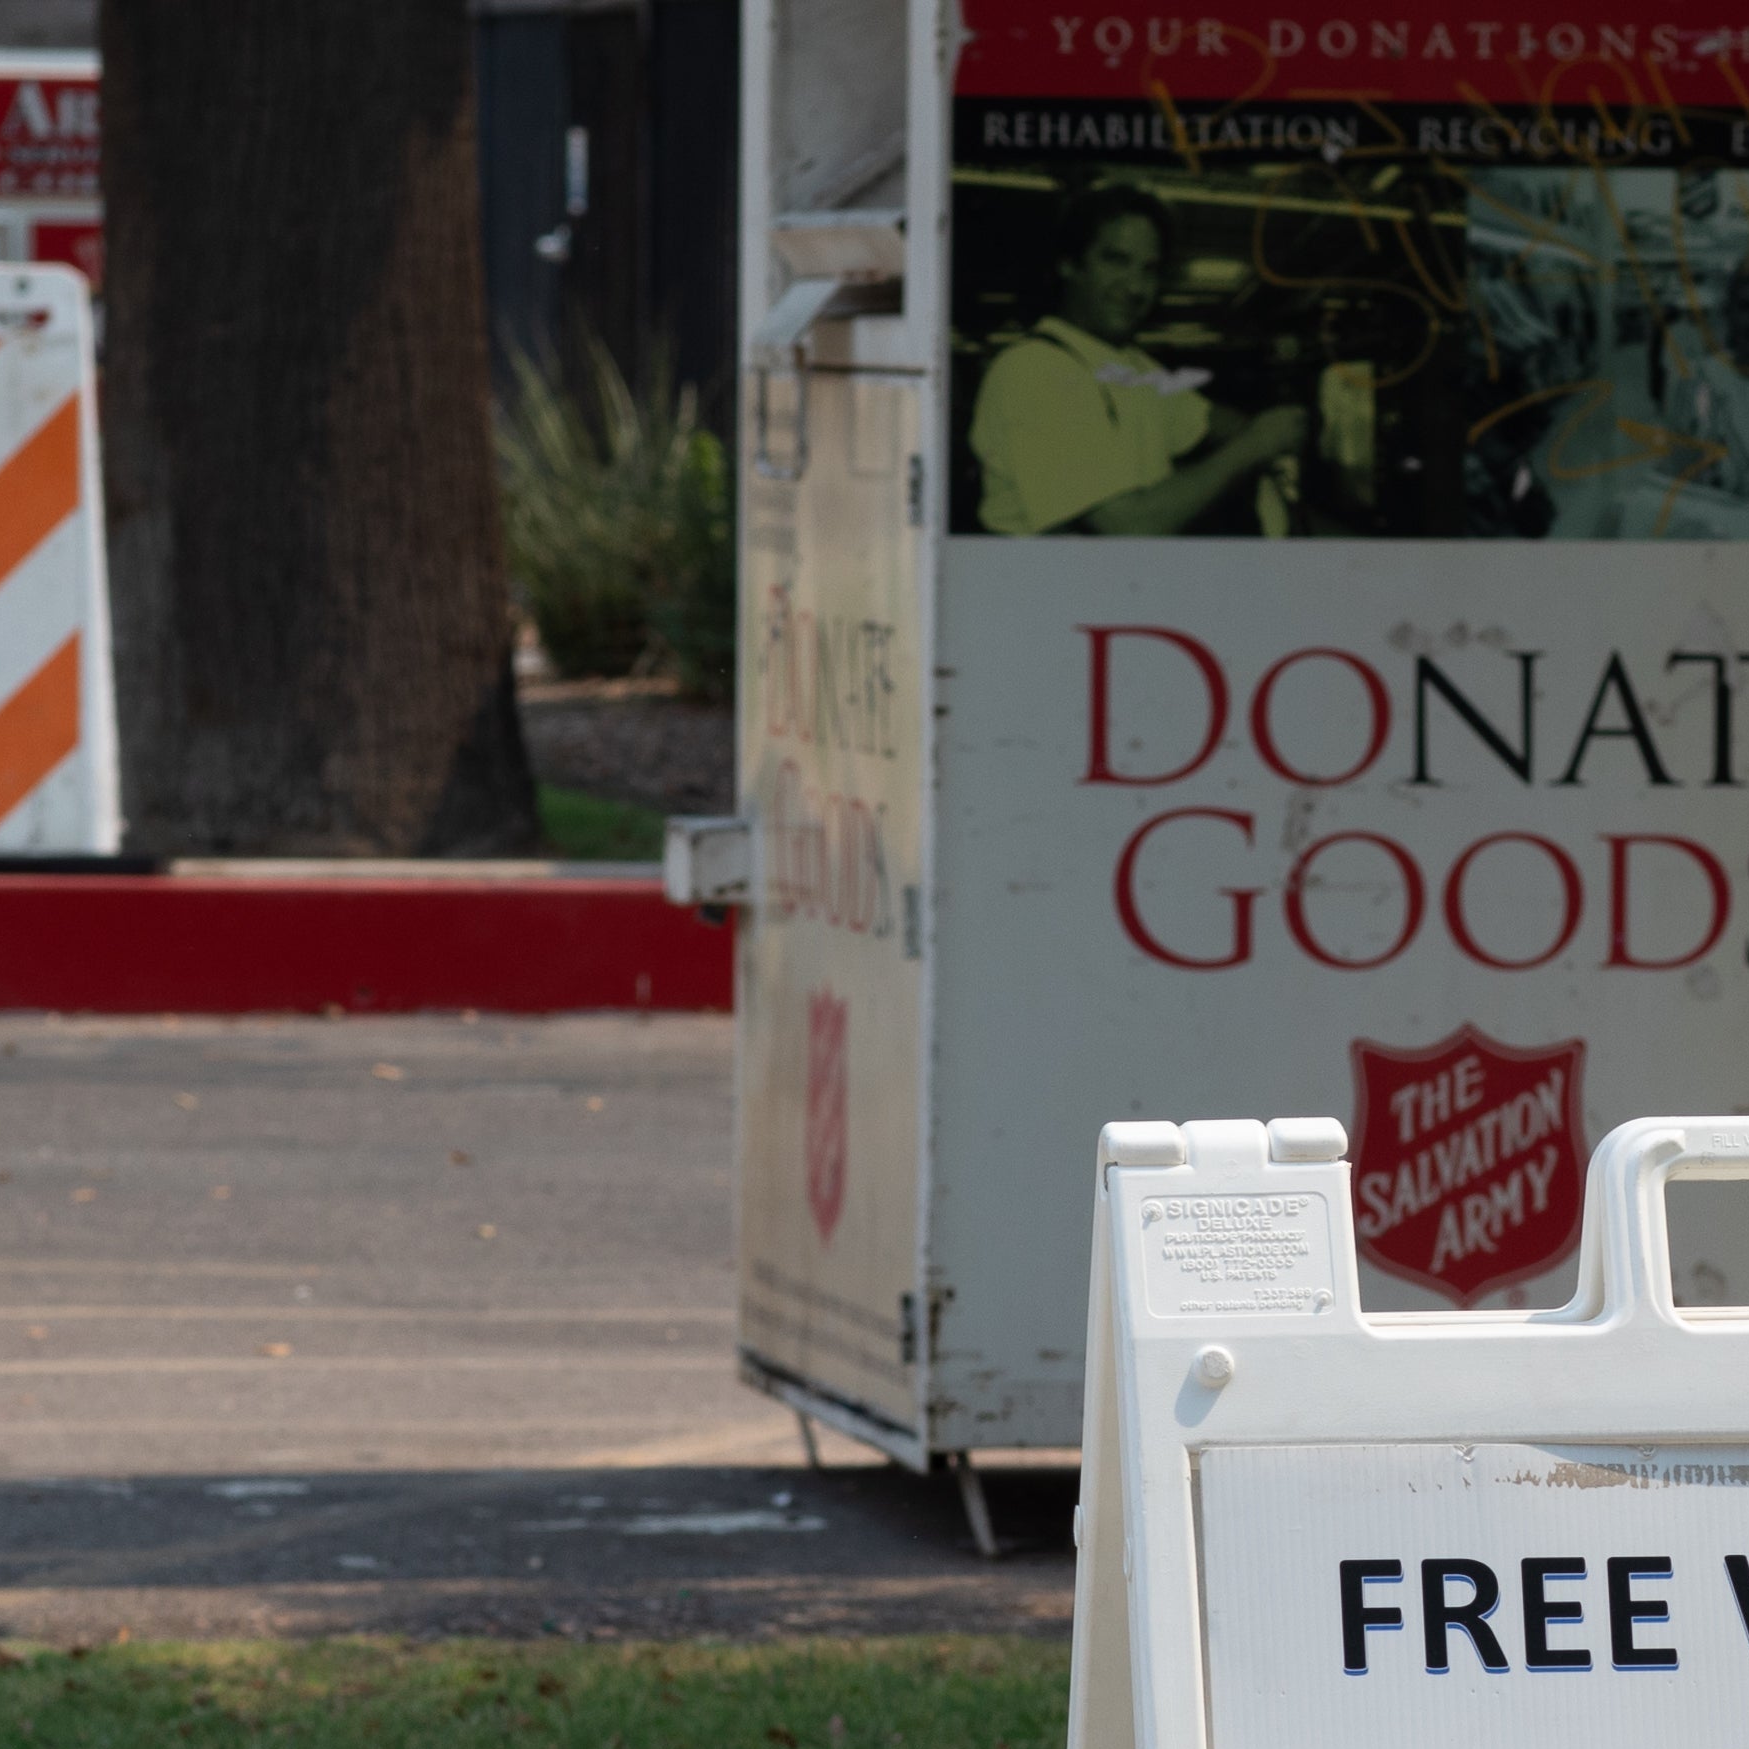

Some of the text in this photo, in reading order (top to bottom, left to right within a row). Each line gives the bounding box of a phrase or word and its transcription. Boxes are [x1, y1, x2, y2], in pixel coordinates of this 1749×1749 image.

[1050, 15, 1229, 57] YOUR
[1266, 18, 1676, 62] DONATIONS
[0, 80, 99, 139] AR
[1389, 1055, 1486, 1145] THE
[1358, 1067, 1565, 1239] SALVATION
[1711, 1132, 1740, 1149] FILL
[1198, 1216, 1273, 1231] DELUXE
[1429, 1143, 1560, 1274] ARMY
[1338, 1555, 1680, 1674] FREE
